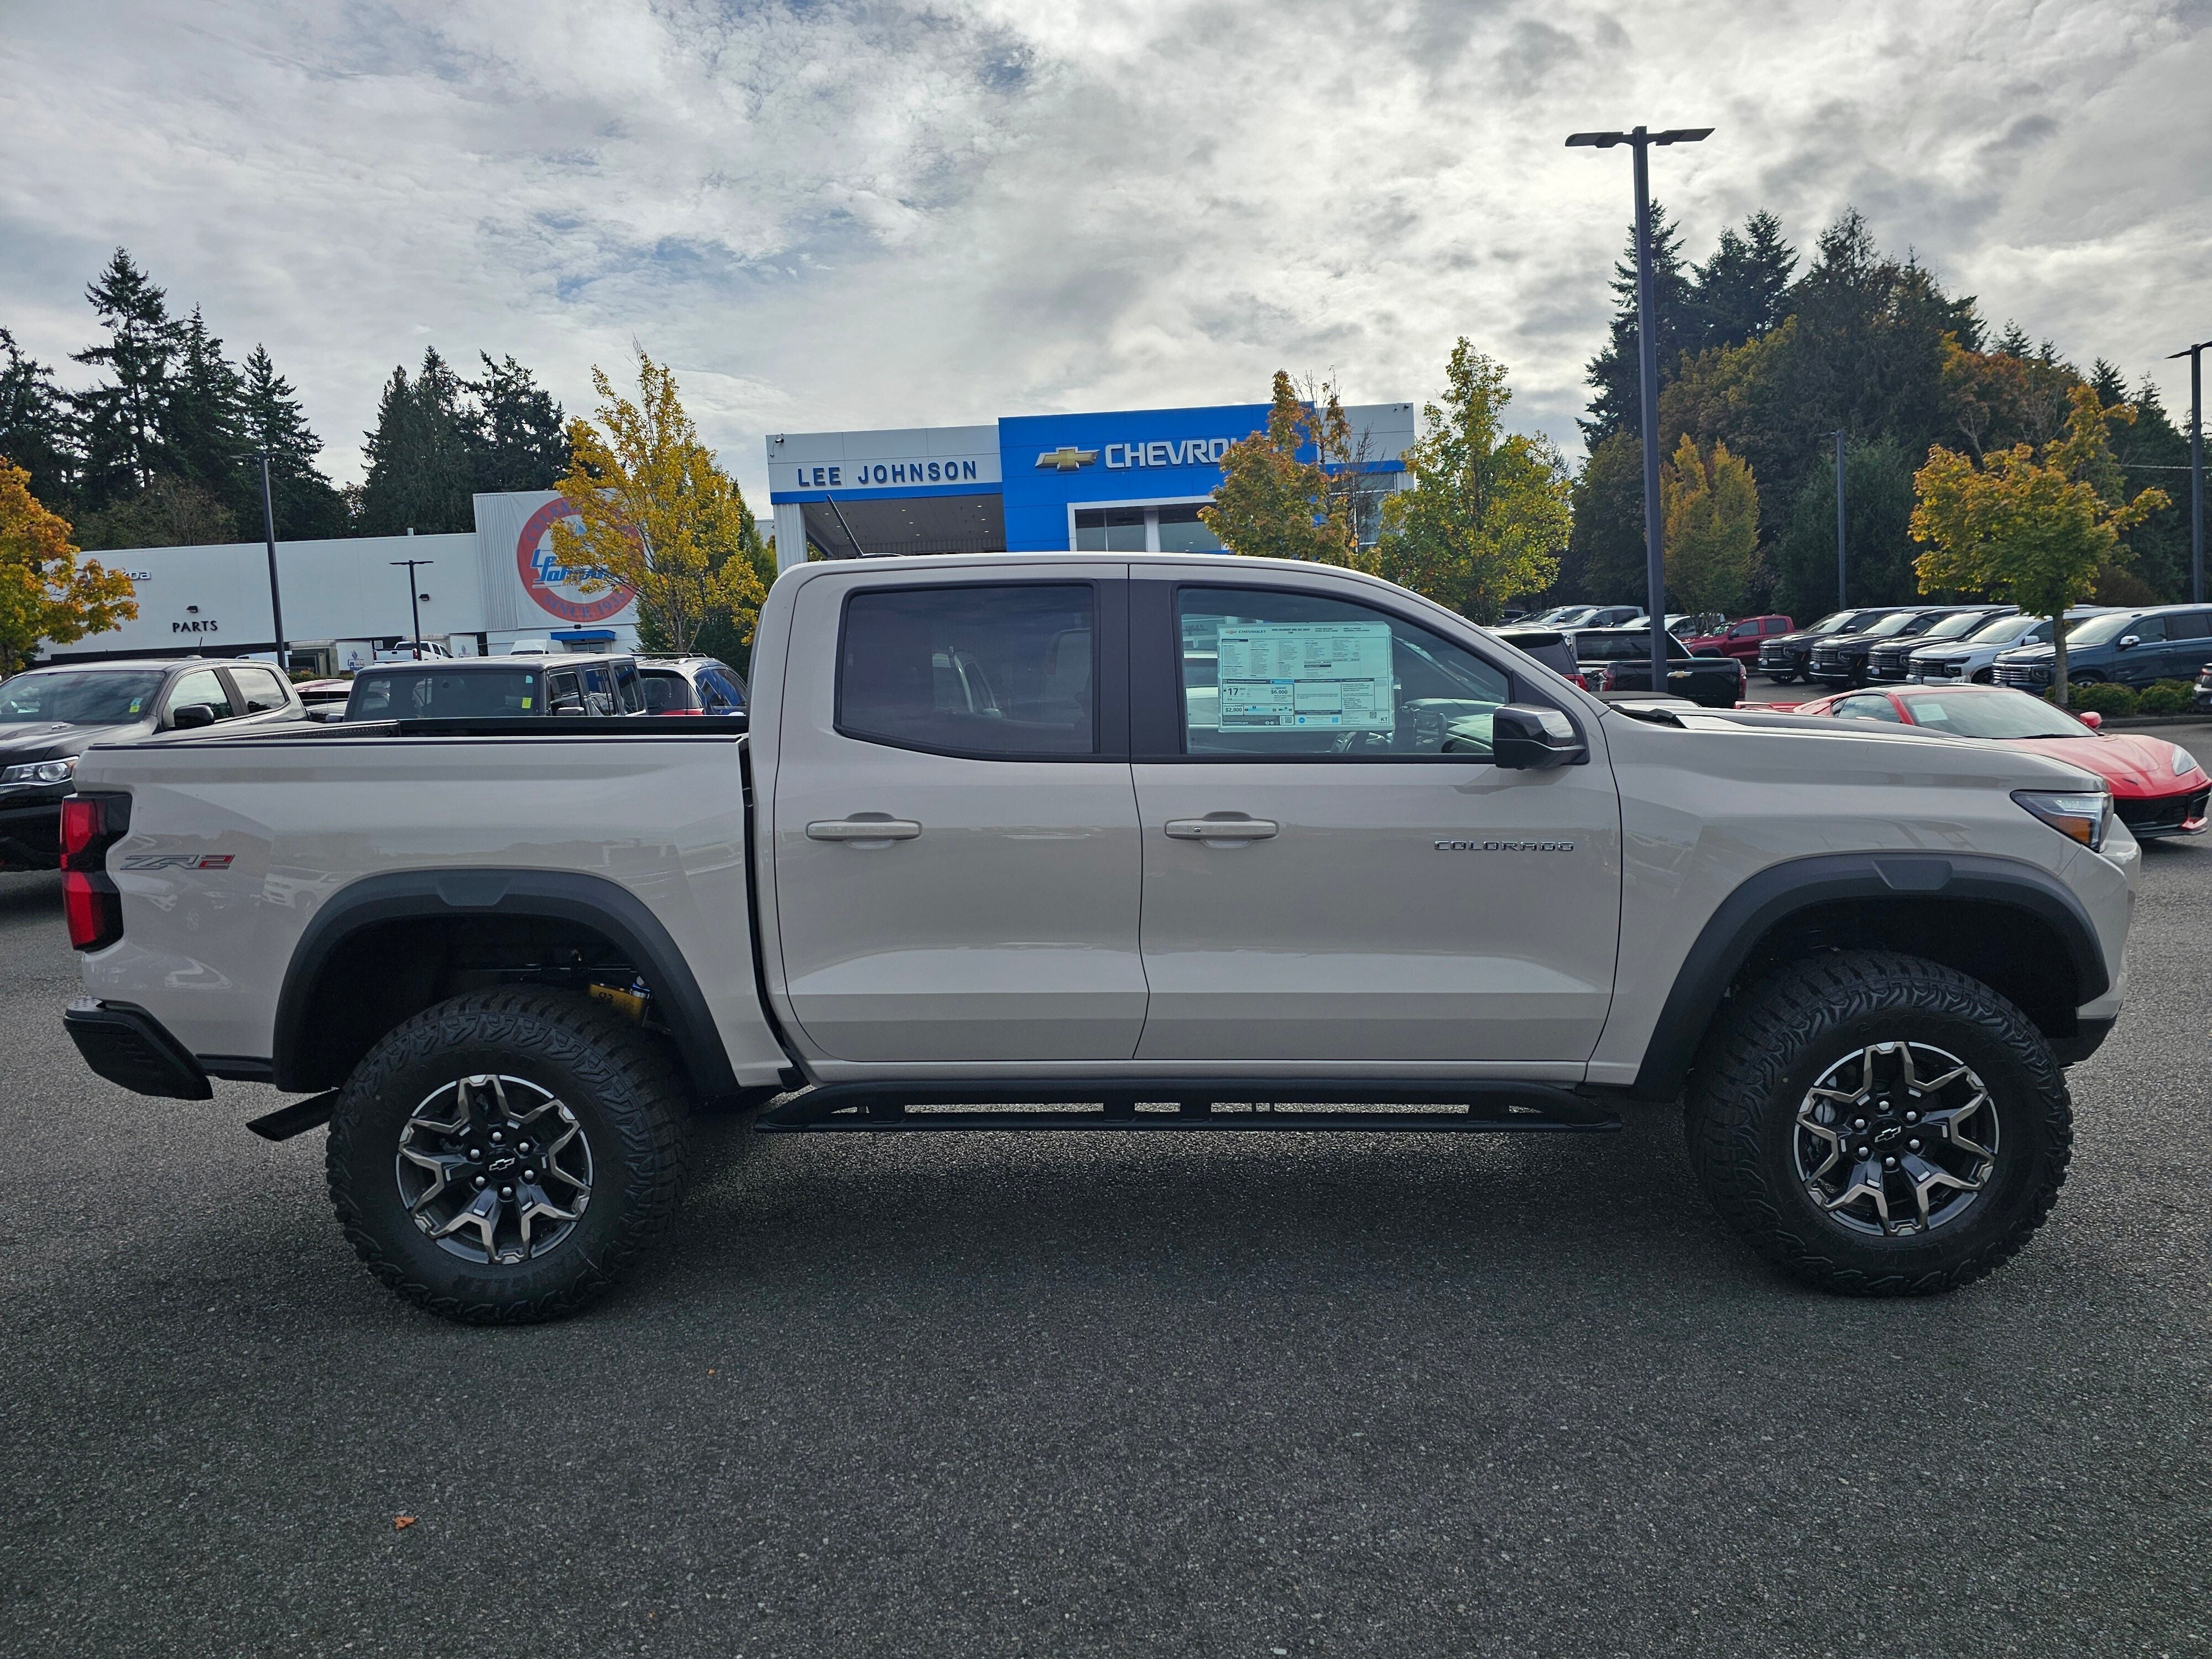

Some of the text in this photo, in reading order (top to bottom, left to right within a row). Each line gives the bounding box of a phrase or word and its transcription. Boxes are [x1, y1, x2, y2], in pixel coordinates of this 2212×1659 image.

[1106, 436, 1279, 468] CHEVRO
[798, 461, 977, 487] LEE JOHNSON
[545, 594, 593, 618] SINCE
[172, 620, 218, 633] PARTS
[1434, 840, 1575, 851] COLORADO
[119, 854, 236, 870] ZR2
